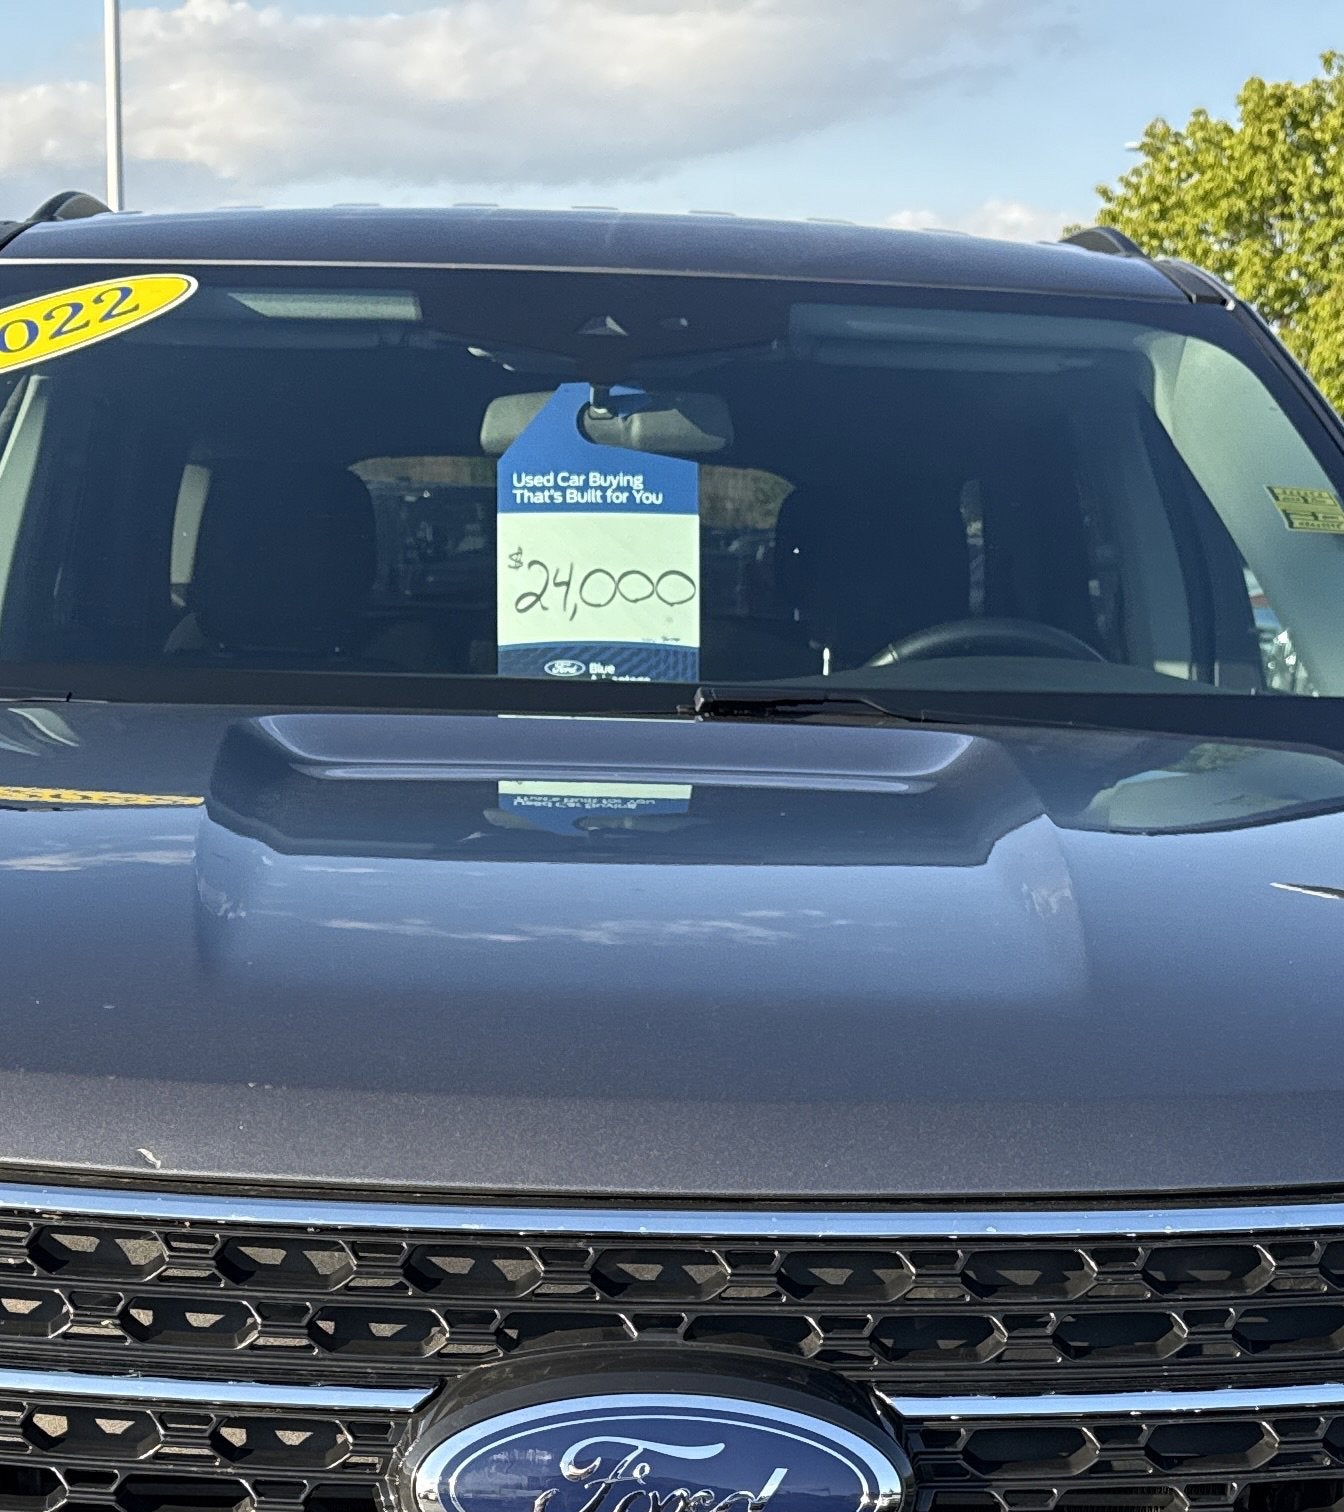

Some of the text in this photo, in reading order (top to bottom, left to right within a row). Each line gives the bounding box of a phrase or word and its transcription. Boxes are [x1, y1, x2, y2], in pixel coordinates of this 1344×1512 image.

[512, 471, 644, 490] Used Car Buying
[512, 488, 664, 505] That's Built for You
[588, 661, 616, 675] Blue
